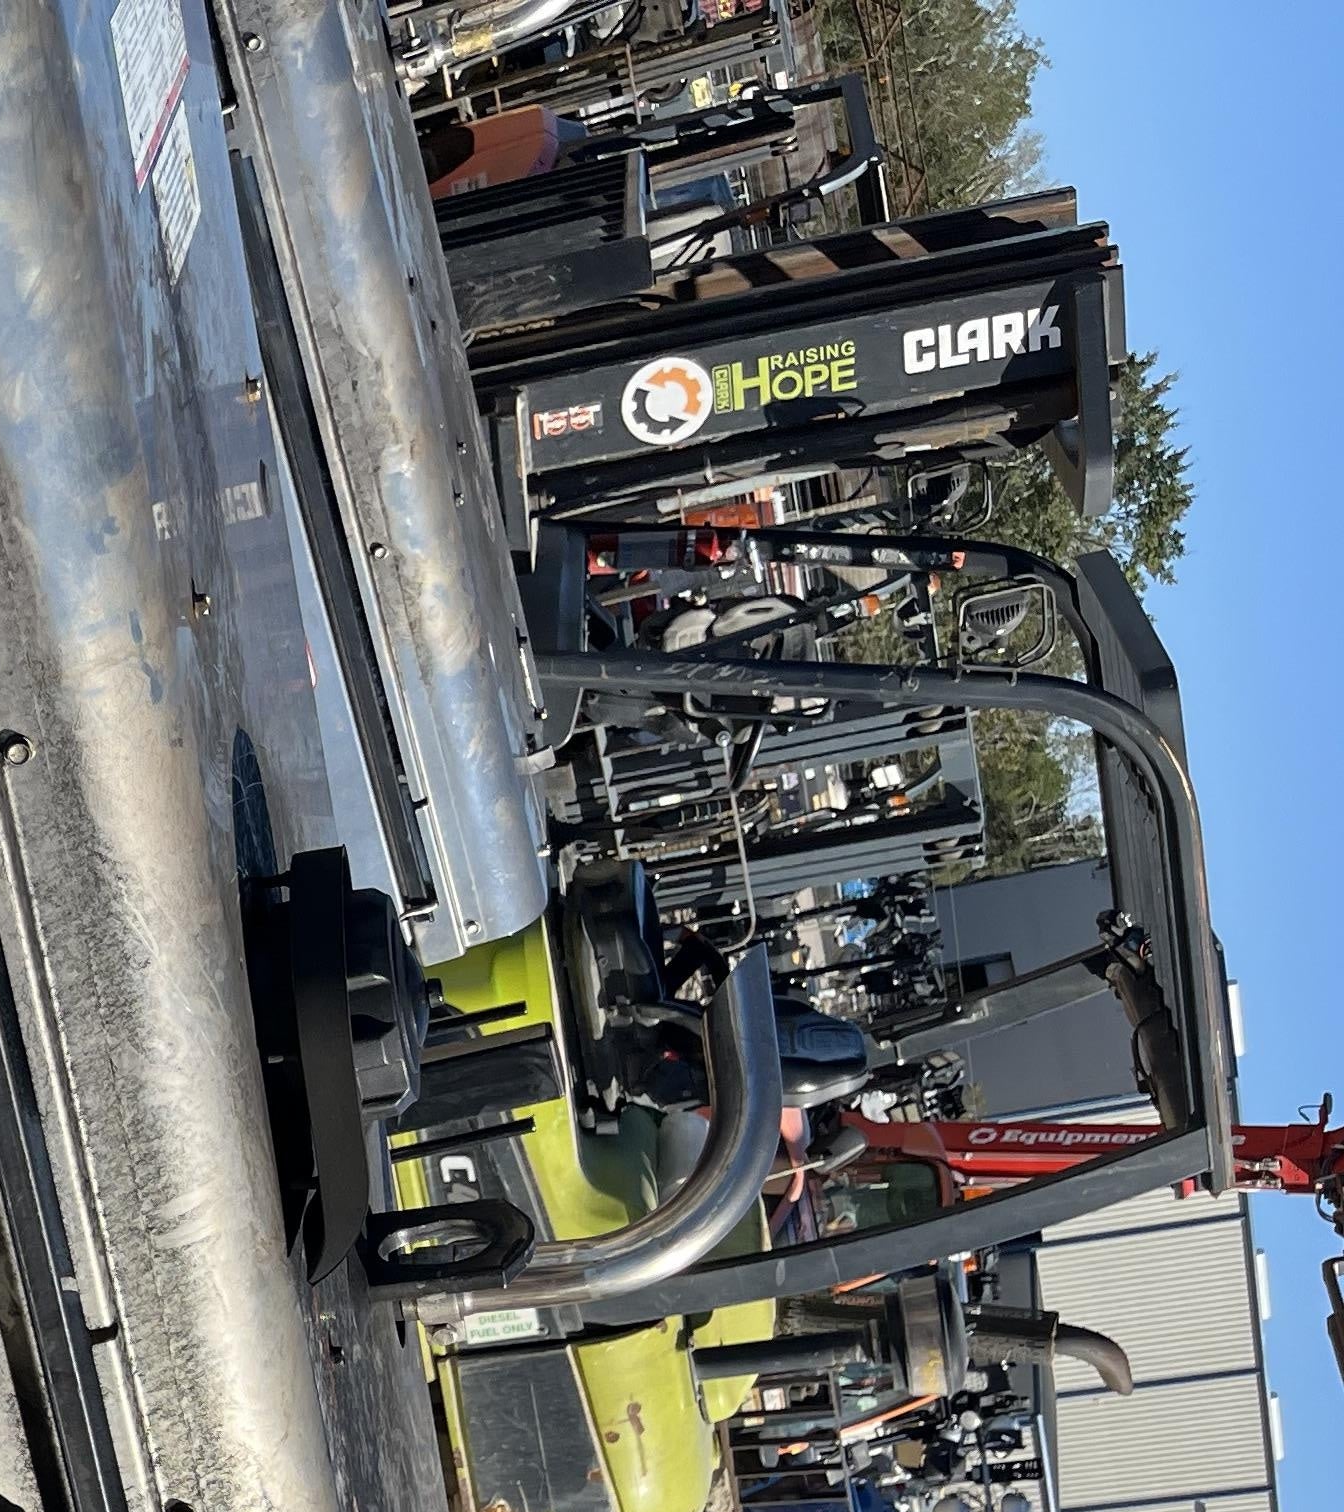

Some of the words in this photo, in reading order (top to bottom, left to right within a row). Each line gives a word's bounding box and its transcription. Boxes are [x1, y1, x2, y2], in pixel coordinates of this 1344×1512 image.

[769, 340, 857, 371] RAISING
[902, 304, 1061, 376] CLARK
[731, 357, 859, 411] HOPE
[470, 1325, 500, 1340] FUEL
[502, 1320, 533, 1337] ONLY
[478, 1311, 521, 1326] DIESEL
